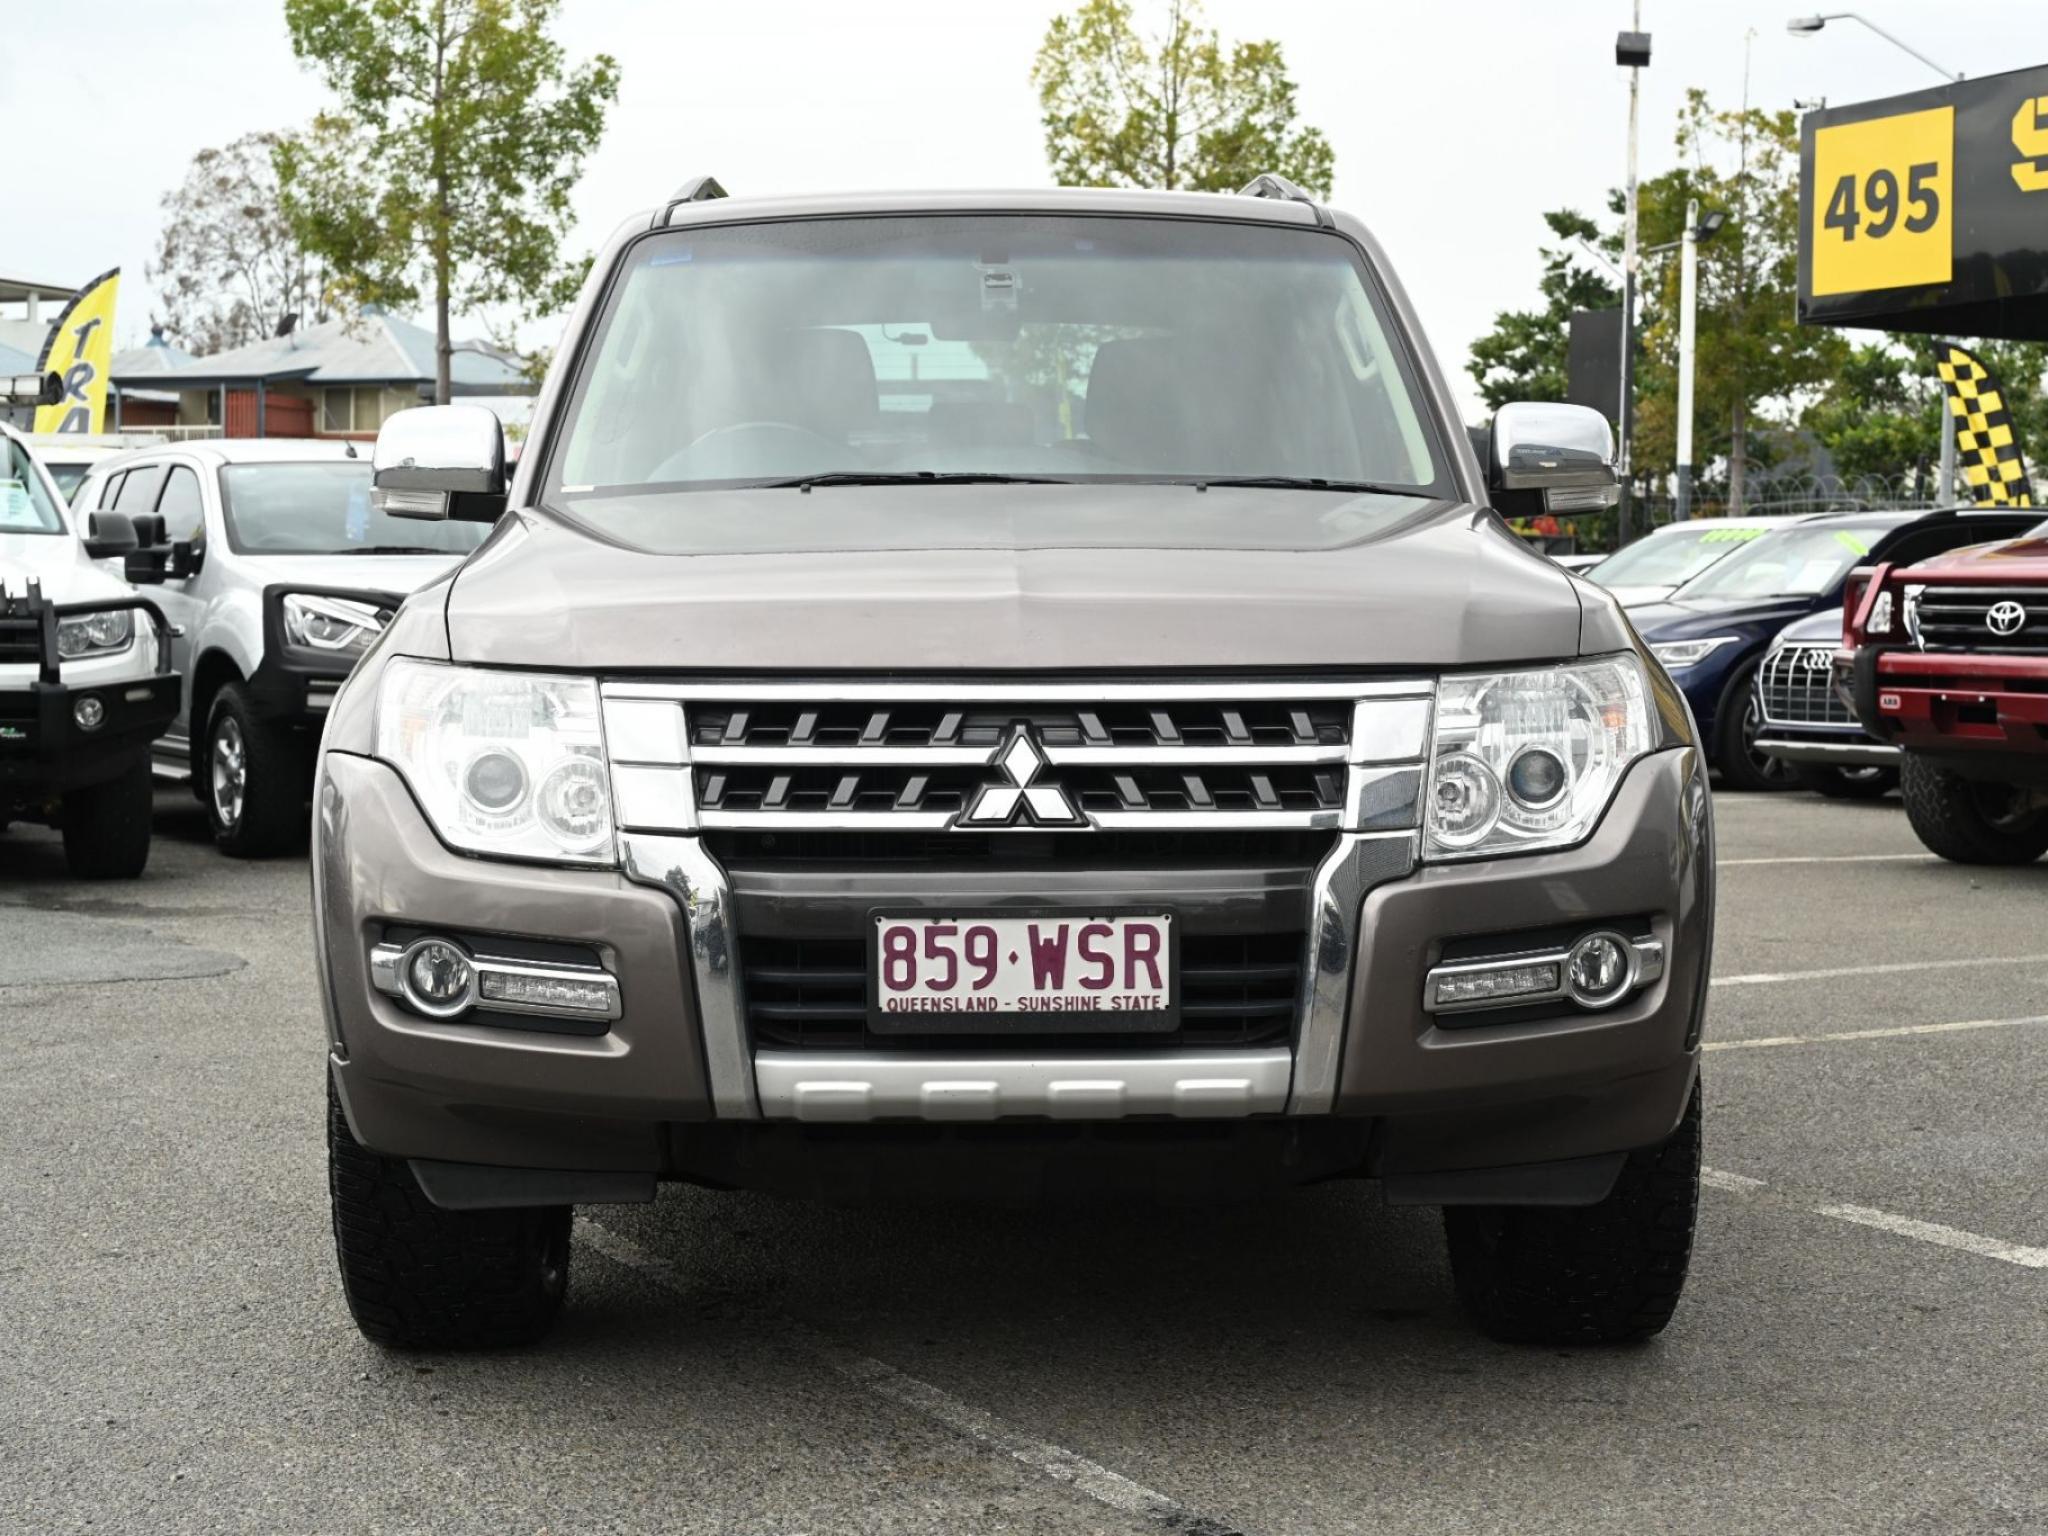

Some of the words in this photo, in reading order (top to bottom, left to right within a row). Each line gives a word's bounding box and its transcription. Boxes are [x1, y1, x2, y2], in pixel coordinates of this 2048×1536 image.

[1824, 162, 1940, 242] 495
[882, 924, 998, 992] 859
[1027, 923, 1164, 991] WSR
[886, 996, 998, 1012] QUEENSLAND
[1017, 996, 1102, 1011] SUNSHINE
[1111, 995, 1161, 1011] STATE
